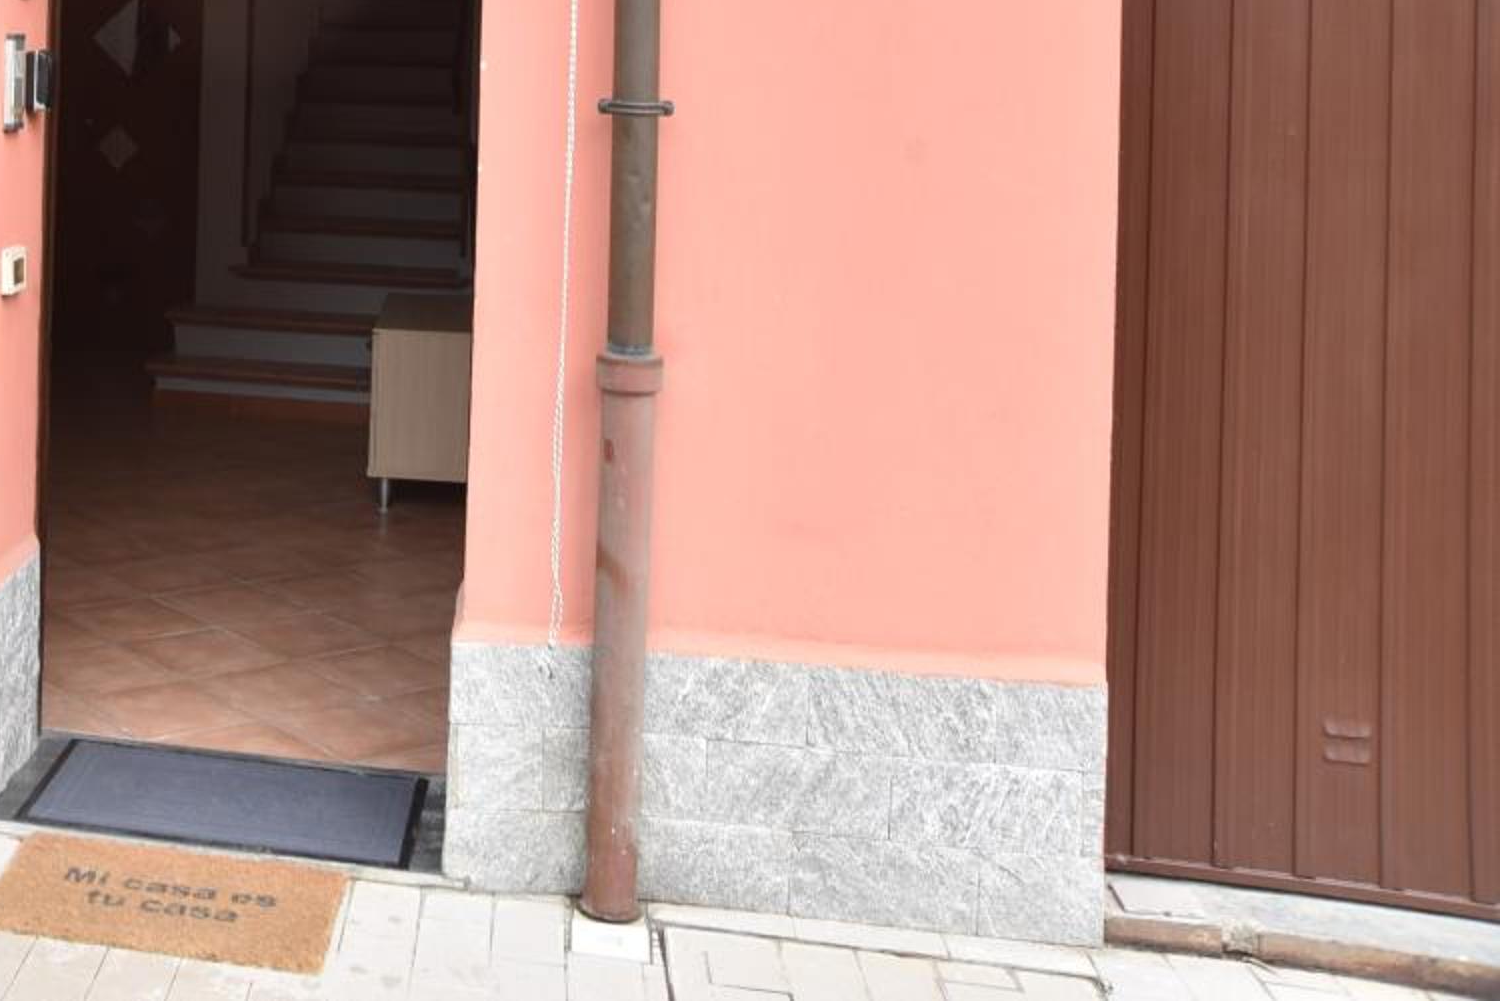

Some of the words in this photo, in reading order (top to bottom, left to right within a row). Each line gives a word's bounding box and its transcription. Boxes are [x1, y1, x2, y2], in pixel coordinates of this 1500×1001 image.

[64, 866, 110, 886] Mi
[123, 878, 218, 900] casa
[86, 889, 125, 907] tu
[140, 900, 238, 923] casa
